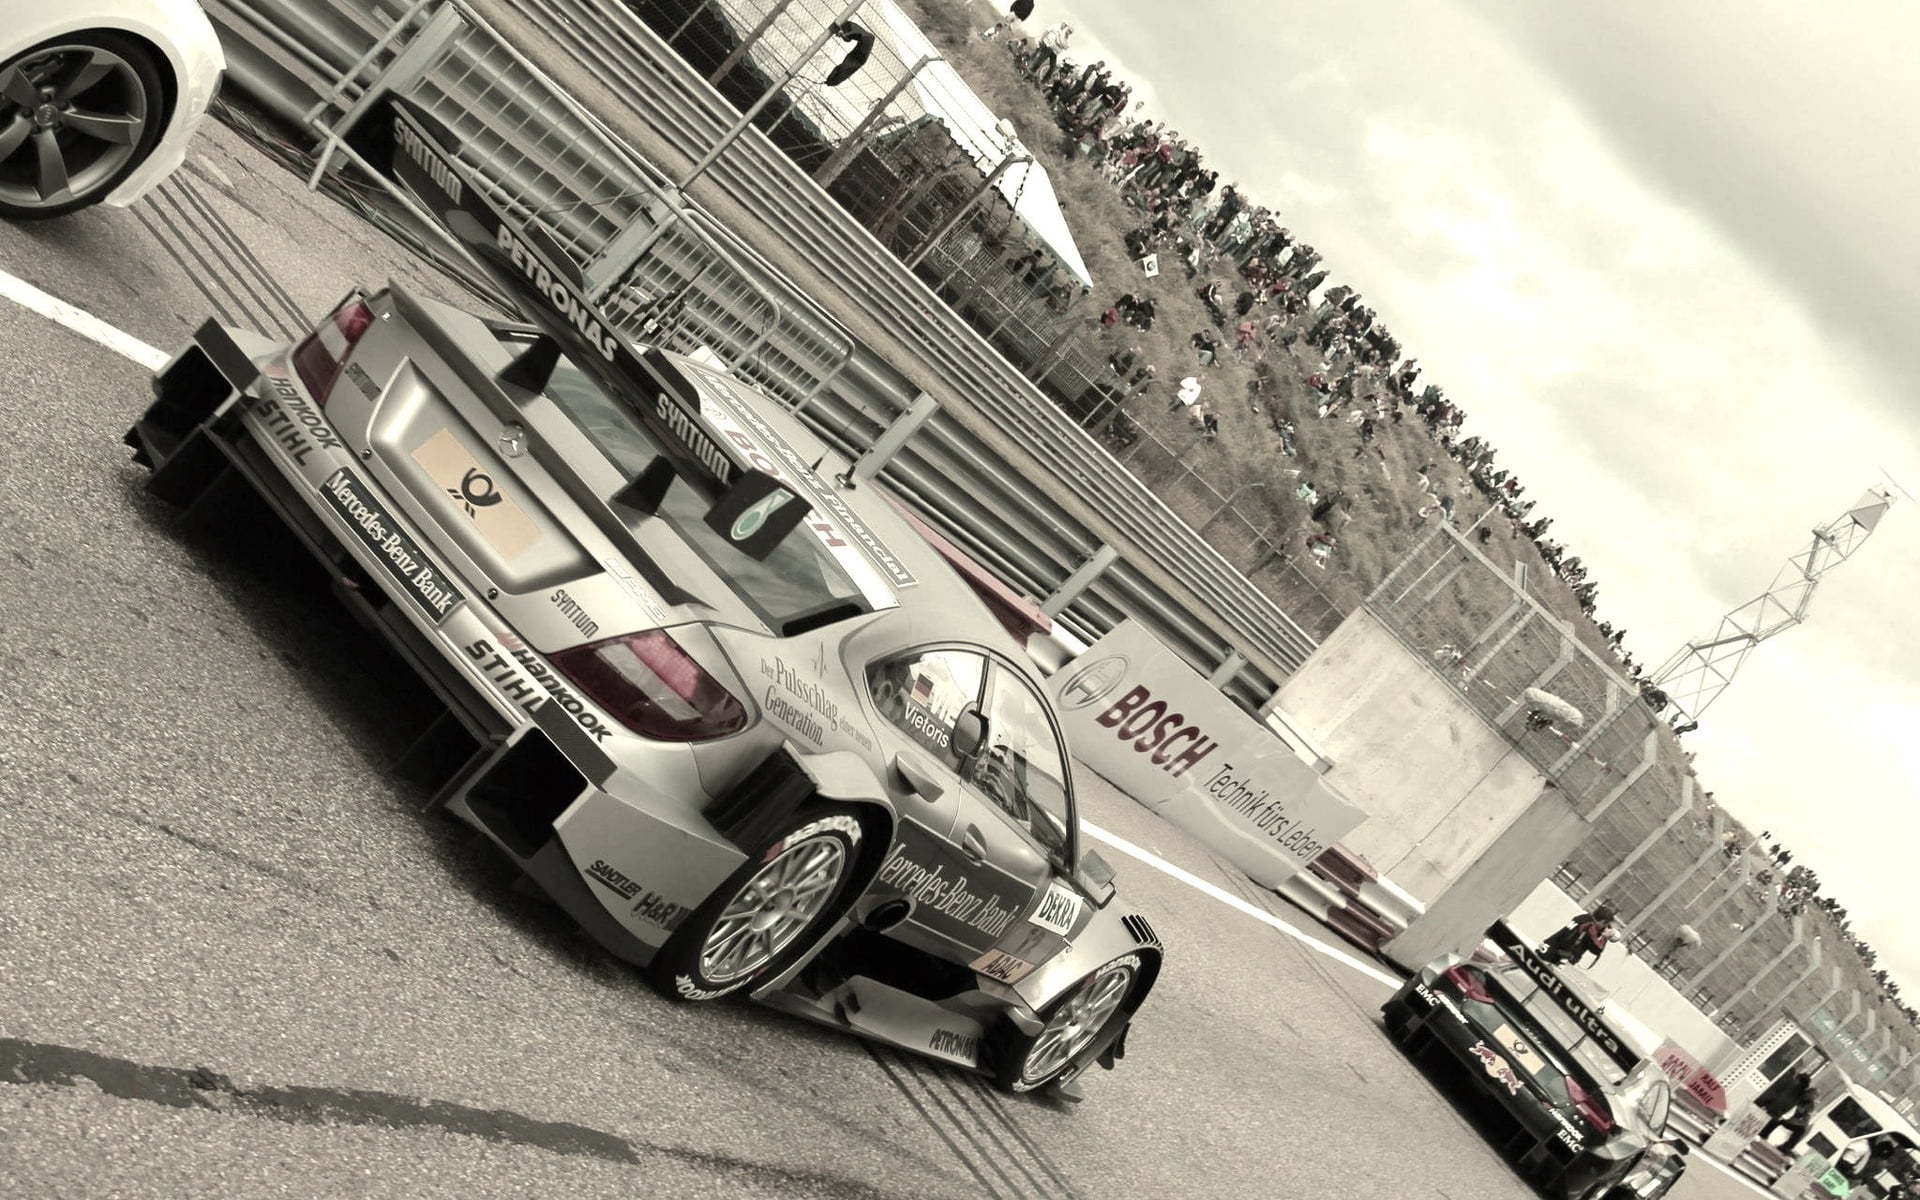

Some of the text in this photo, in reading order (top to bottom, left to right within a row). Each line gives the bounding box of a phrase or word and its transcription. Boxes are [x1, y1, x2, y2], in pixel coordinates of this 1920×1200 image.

[498, 223, 618, 362] PETRONAS
[257, 400, 313, 467] STIHL
[656, 392, 731, 485] SYNTIUM
[702, 371, 910, 581] Mercedes-Benz Financial
[326, 470, 453, 615] Mercedes-Benz Bank
[550, 589, 599, 639] SYNTIUM
[465, 639, 546, 714] STIHL
[775, 656, 838, 732] Pulsschlag
[764, 685, 823, 747] Generation.
[904, 702, 949, 748] Vietoris
[1095, 685, 1218, 778] BOSCH
[1203, 763, 1323, 861] Technik fürs Leben
[968, 894, 1019, 938] Bank
[1038, 892, 1077, 930] DEKRA
[980, 954, 1020, 979] ADAC
[1509, 944, 1619, 1054] Audi ultra
